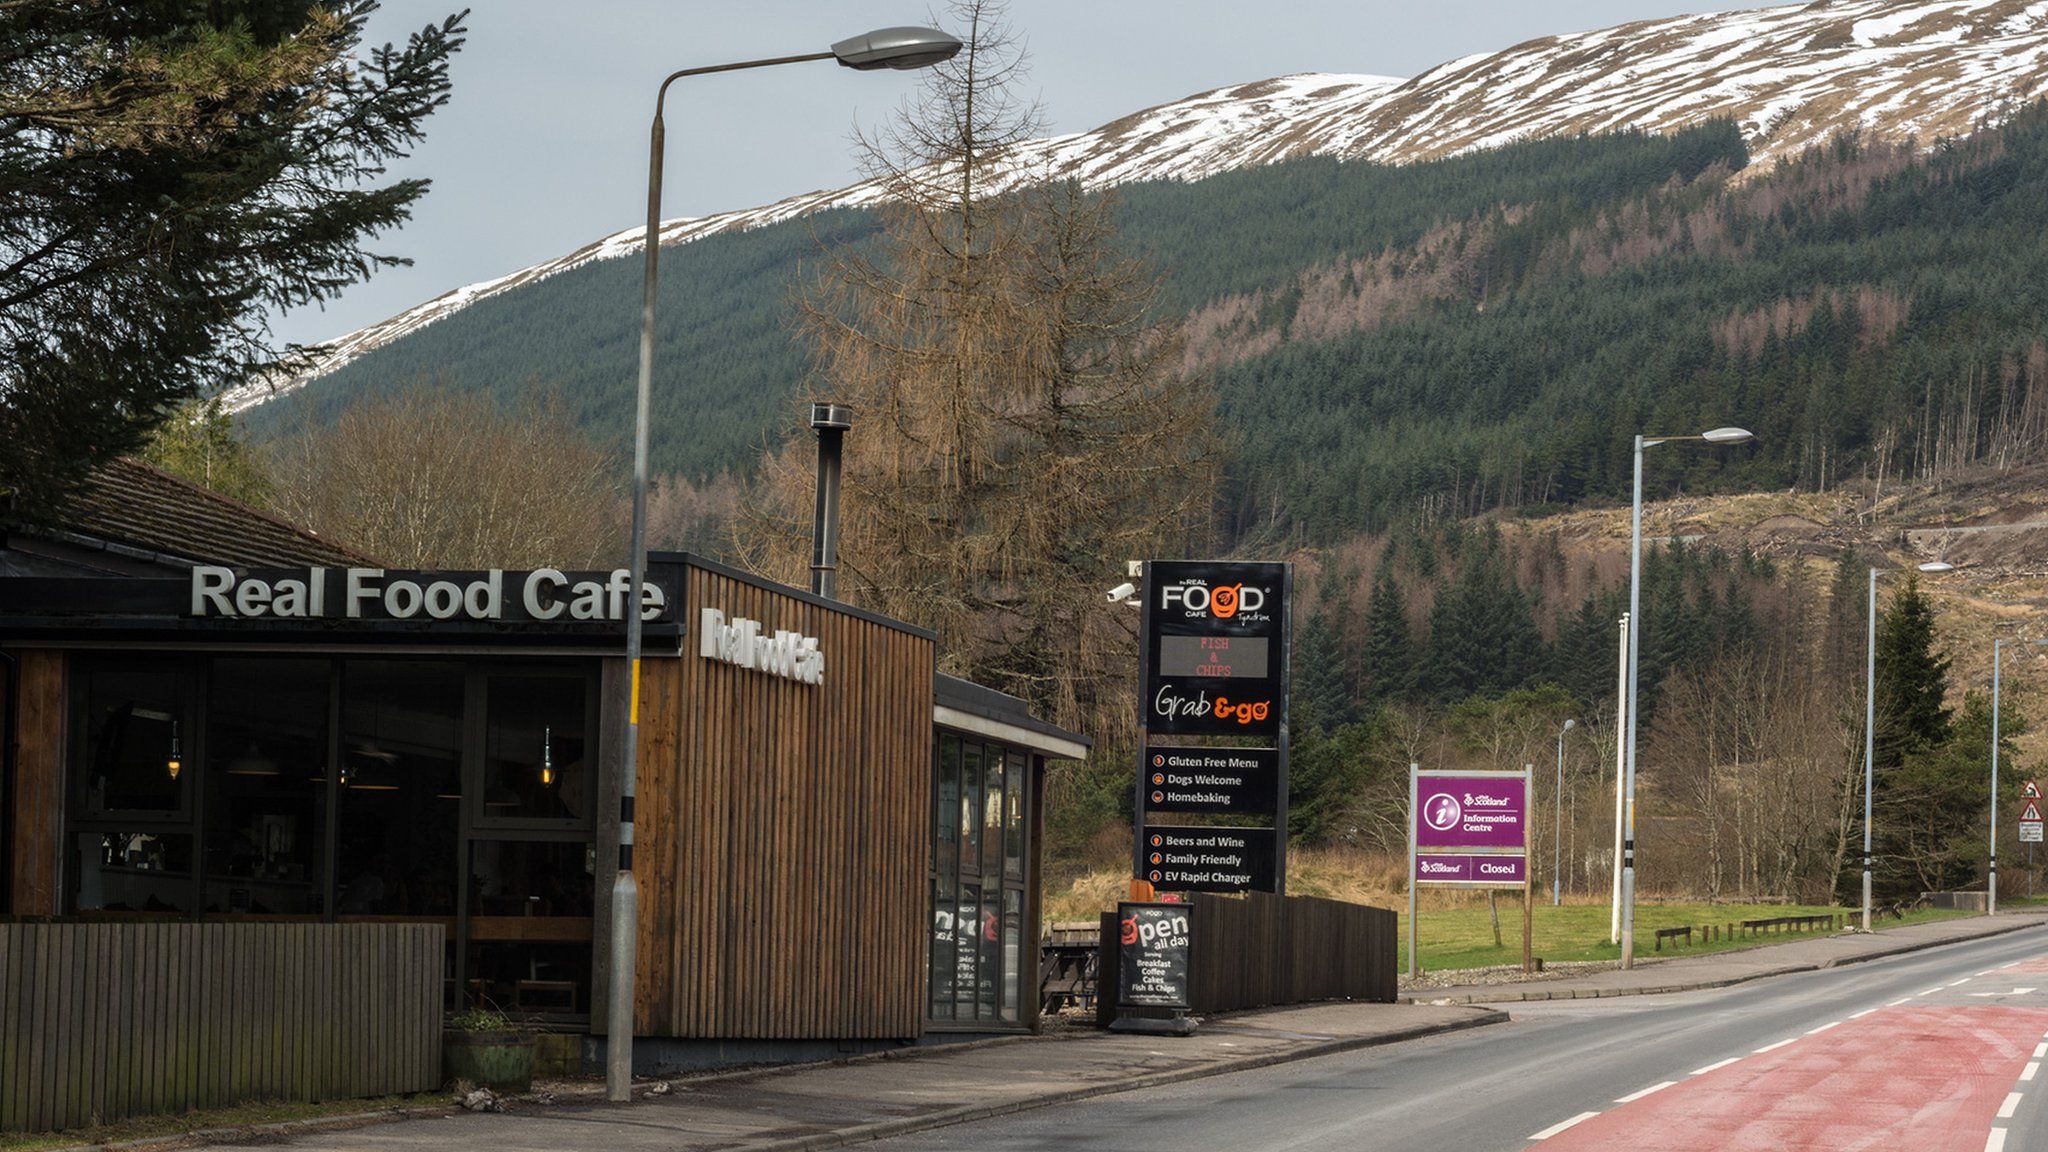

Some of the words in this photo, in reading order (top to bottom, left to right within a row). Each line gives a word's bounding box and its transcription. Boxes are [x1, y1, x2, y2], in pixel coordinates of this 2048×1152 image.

[191, 565, 325, 617] Real
[346, 567, 503, 620] Food
[523, 568, 665, 621] Cafe
[1162, 582, 1264, 618] FOOD
[1185, 610, 1207, 618] CAFE
[1201, 638, 1229, 649] FISH
[1210, 652, 1217, 662] &
[1196, 665, 1231, 676] CHIPS
[1156, 684, 1211, 721] Grab
[1168, 756, 1202, 767] Gluten
[1204, 757, 1227, 767] Free
[1228, 758, 1259, 768] Menu
[1168, 774, 1193, 786] Dogs
[1195, 775, 1242, 786] Welcome
[1167, 792, 1230, 805] Homebaking
[1463, 815, 1517, 823] Information
[1463, 823, 1493, 832] Centre
[1166, 836, 1194, 846] Beers
[1196, 837, 1216, 847] and
[1218, 837, 1245, 847] Wine
[1165, 854, 1199, 866] Family
[1200, 855, 1242, 867] Friendly
[1480, 863, 1515, 873] Closed
[1165, 872, 1179, 882] EV
[1180, 872, 1210, 883] Rapid
[1211, 872, 1251, 884] Charger
[1154, 938, 1168, 950] all
[1170, 936, 1189, 947] day
[1136, 960, 1171, 968] Breakfast
[1141, 968, 1166, 976] Coffee
[1143, 976, 1164, 984] Cakes
[1132, 984, 1146, 992] Fish
[1147, 984, 1155, 992] &
[1156, 985, 1176, 993] Chips
